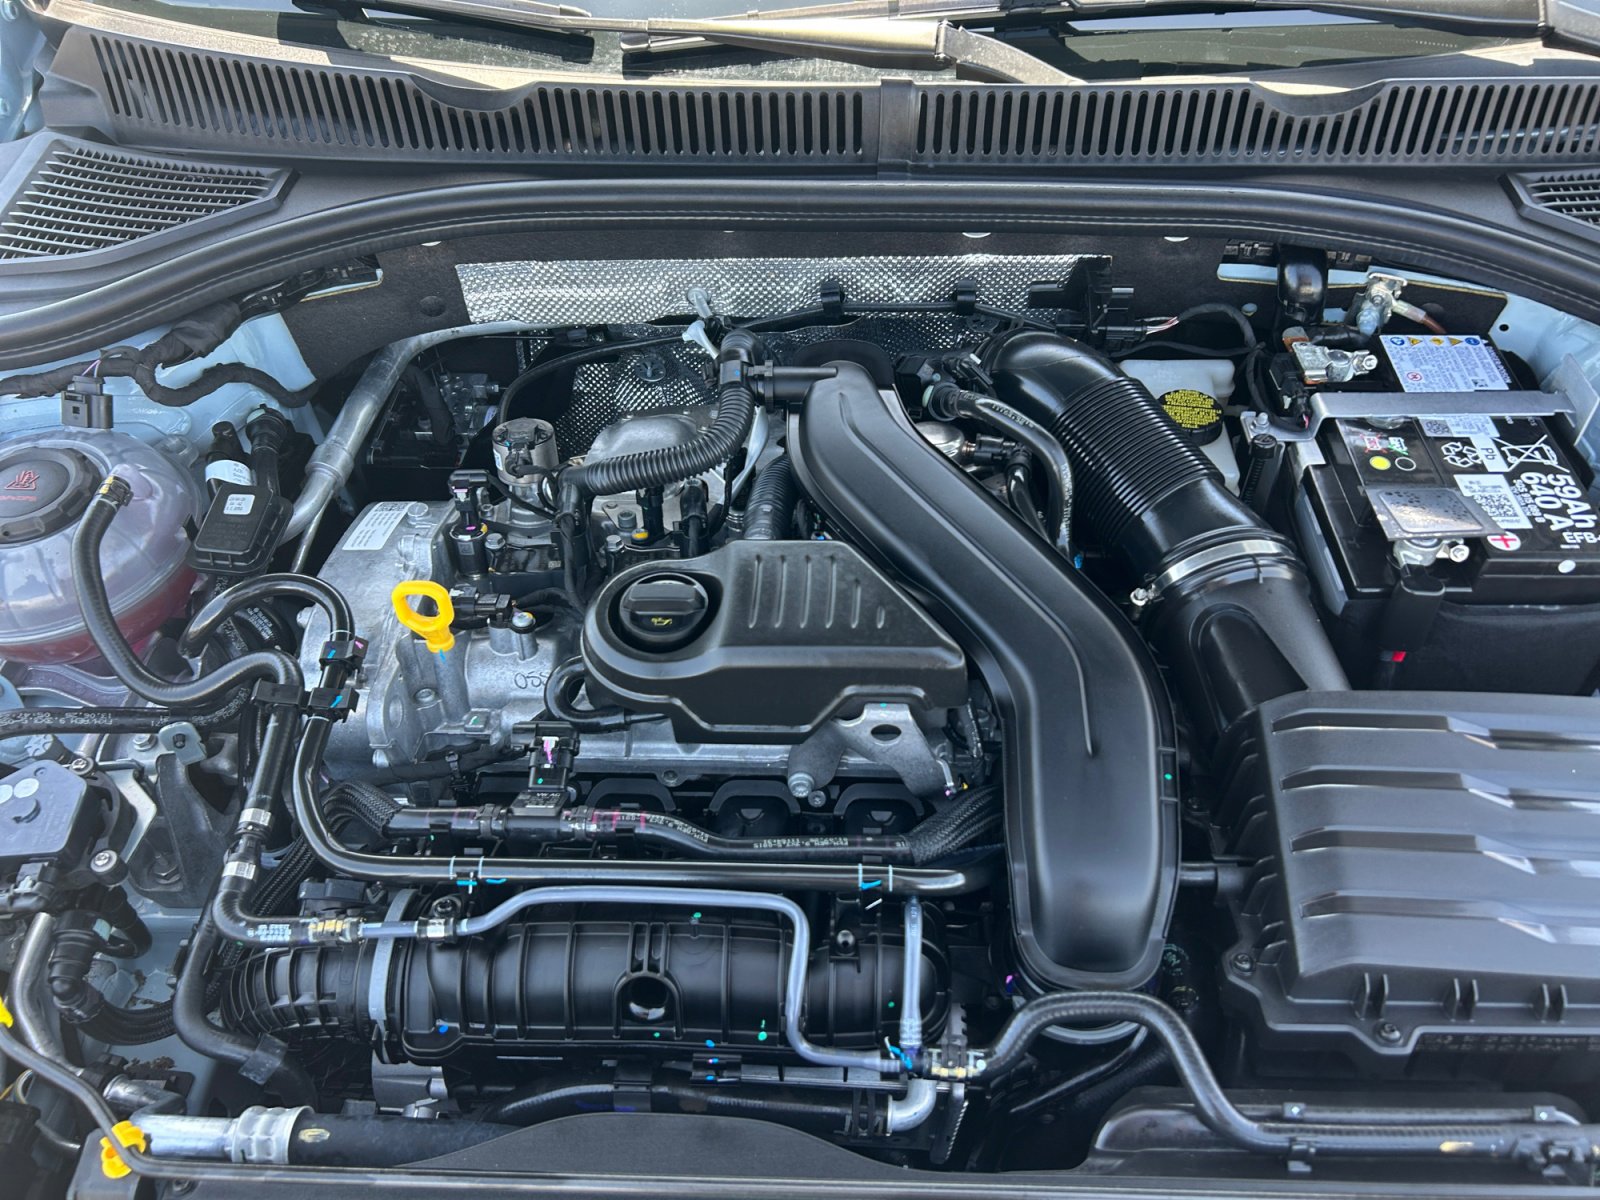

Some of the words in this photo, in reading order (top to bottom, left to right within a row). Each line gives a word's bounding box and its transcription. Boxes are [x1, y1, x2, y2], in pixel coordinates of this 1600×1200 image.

[1480, 447, 1496, 461] Pb
[1520, 472, 1563, 510] 640
[1543, 513, 1575, 531] A
[1547, 473, 1598, 528] 59Ah
